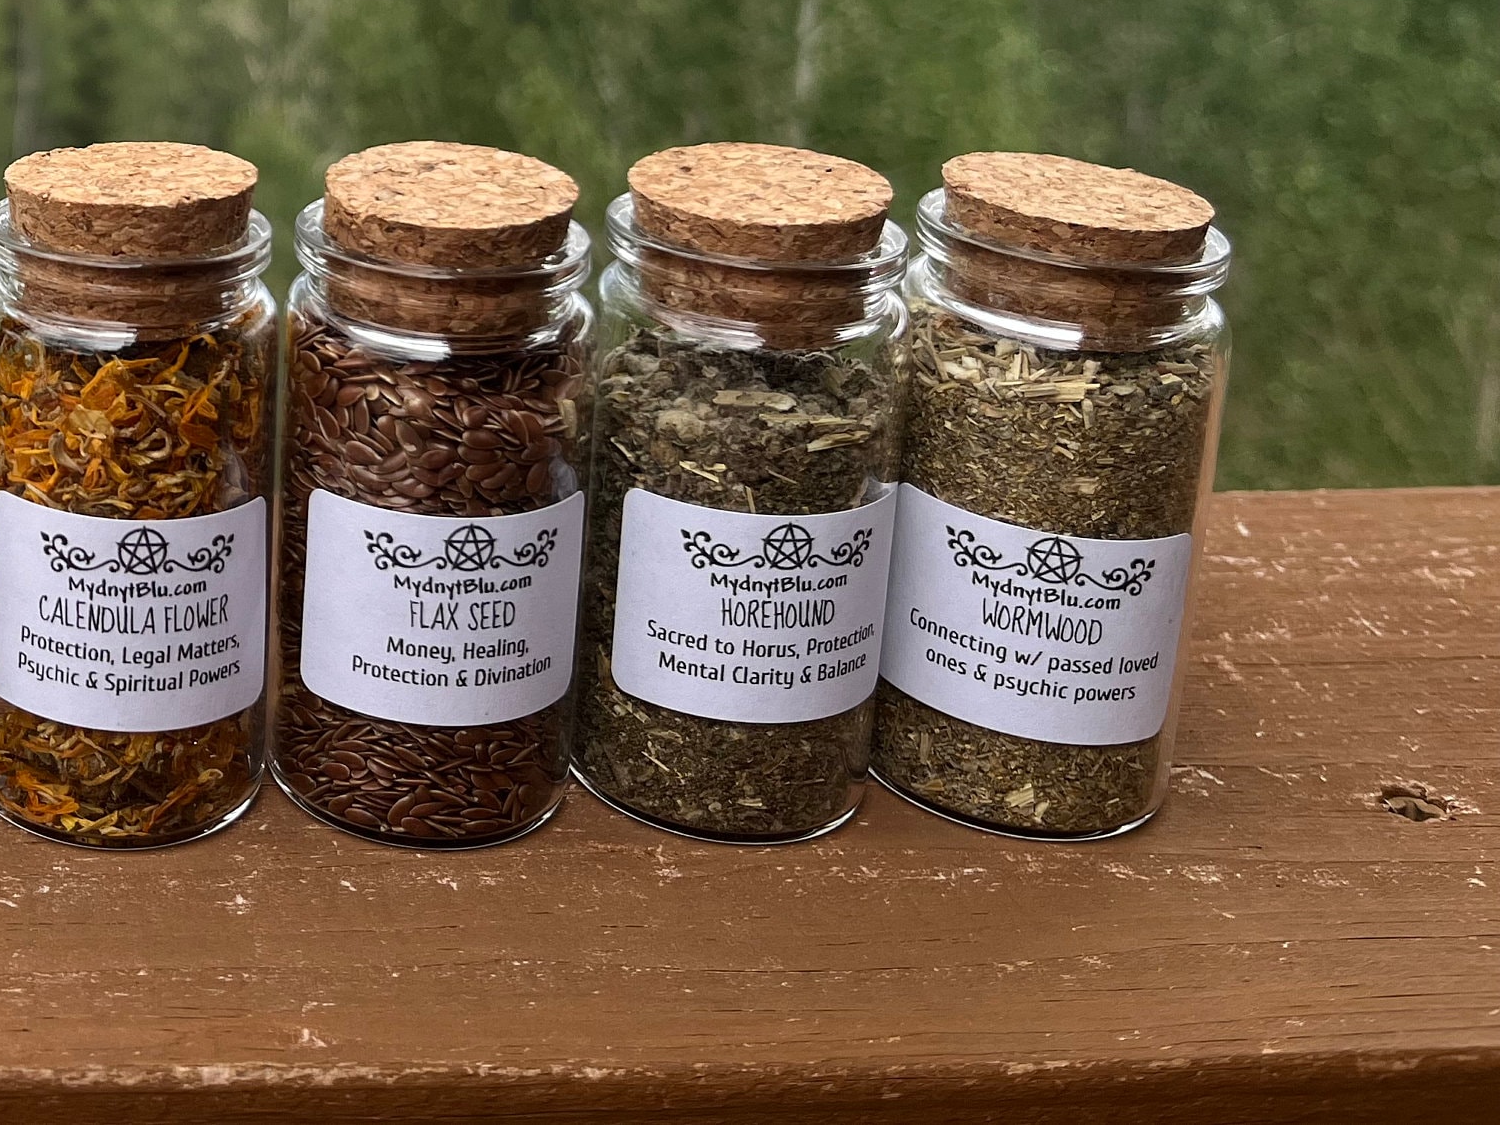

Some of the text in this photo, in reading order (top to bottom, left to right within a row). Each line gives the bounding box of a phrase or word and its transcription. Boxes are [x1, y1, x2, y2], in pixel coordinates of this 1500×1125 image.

[68, 576, 208, 603] MydnytBlu.com
[394, 574, 532, 600] MydnytBlu.com
[710, 573, 848, 598] MydnytBlu.com
[972, 571, 1121, 610] MydnytBlu.com
[38, 594, 229, 635] CALENDULA FLOWER
[410, 600, 516, 631] FLAX SEED
[721, 598, 835, 629] HOREHOUND
[982, 598, 1102, 645] WORMWOOD
[21, 625, 240, 668] Protection, Legal Matters,
[386, 636, 529, 664] Money, Healing,
[647, 619, 707, 650] Sacred
[715, 638, 734, 655] to
[742, 640, 800, 659] Horus,
[910, 608, 1158, 675] Connecting w/ passed loved
[18, 651, 240, 695] Psychic & Spiritual Powers
[352, 655, 551, 686] Protection & Divination
[659, 651, 866, 689] Mental Clarity & Balance
[926, 648, 1136, 704] ones & psychic powers
